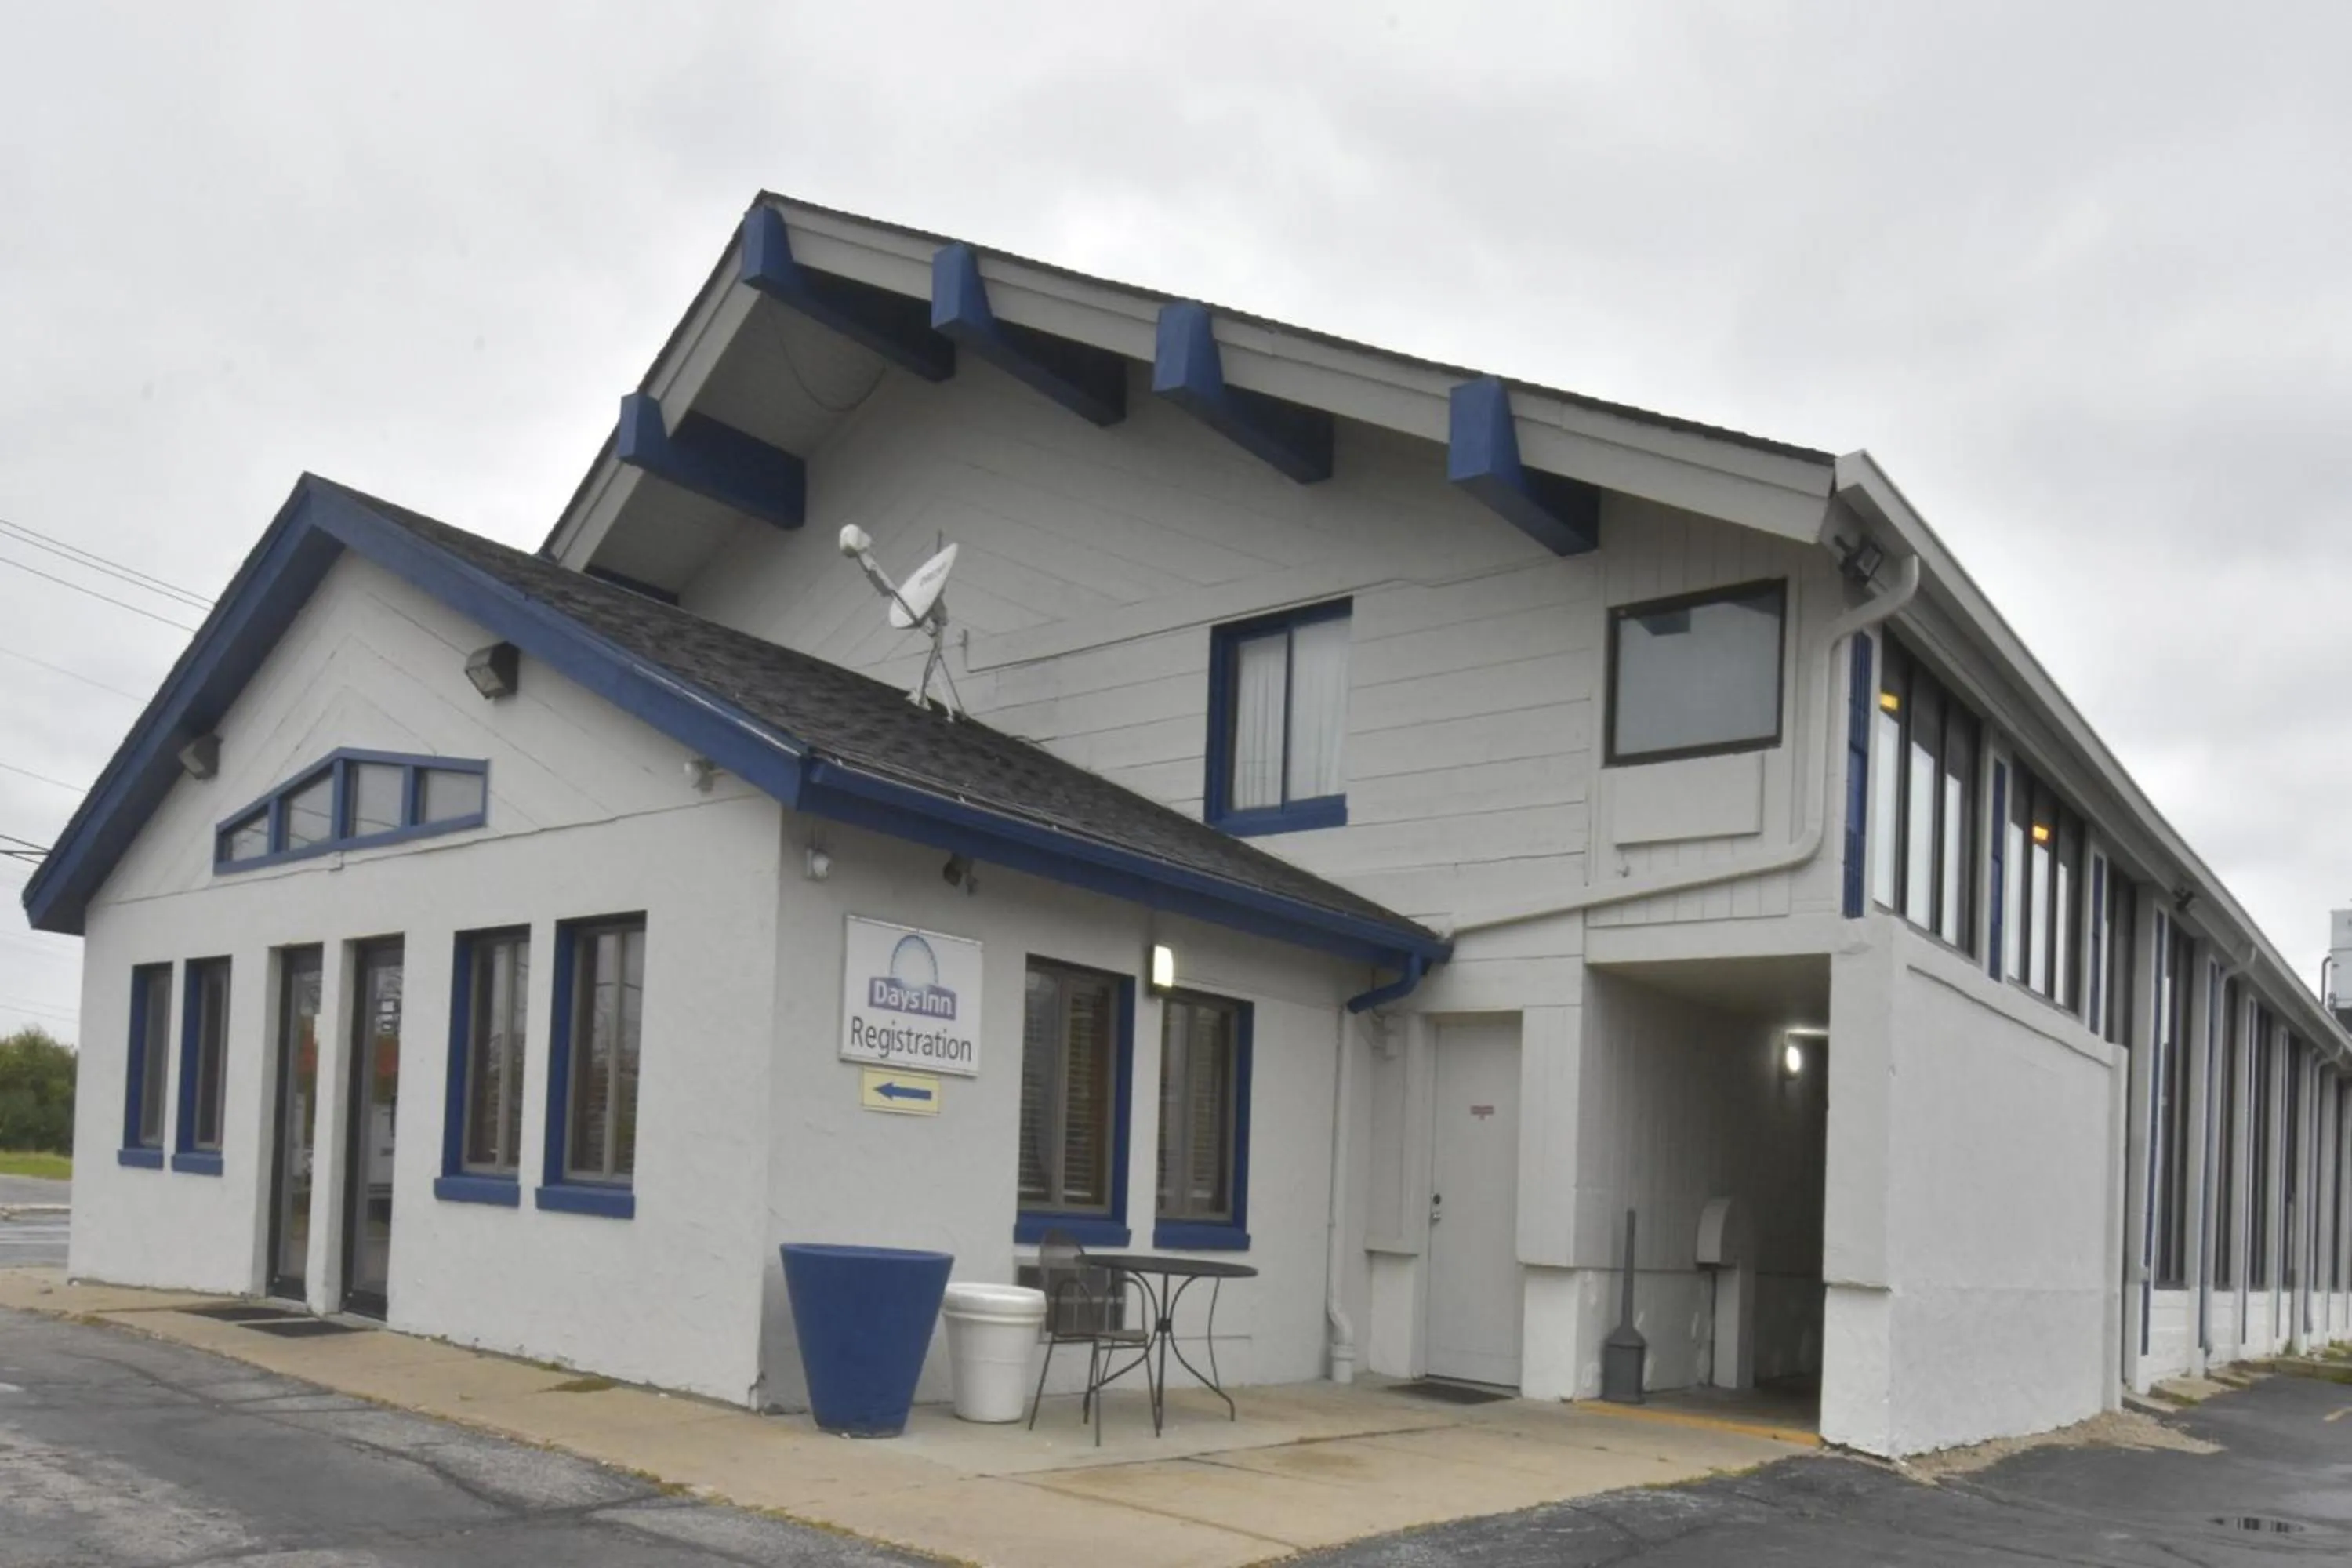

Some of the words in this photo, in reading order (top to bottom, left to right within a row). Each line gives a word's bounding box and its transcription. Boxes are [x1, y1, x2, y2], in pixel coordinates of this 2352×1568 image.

[874, 980, 920, 1011] Days
[921, 989, 953, 1016] Inn
[851, 1015, 972, 1062] Registration
